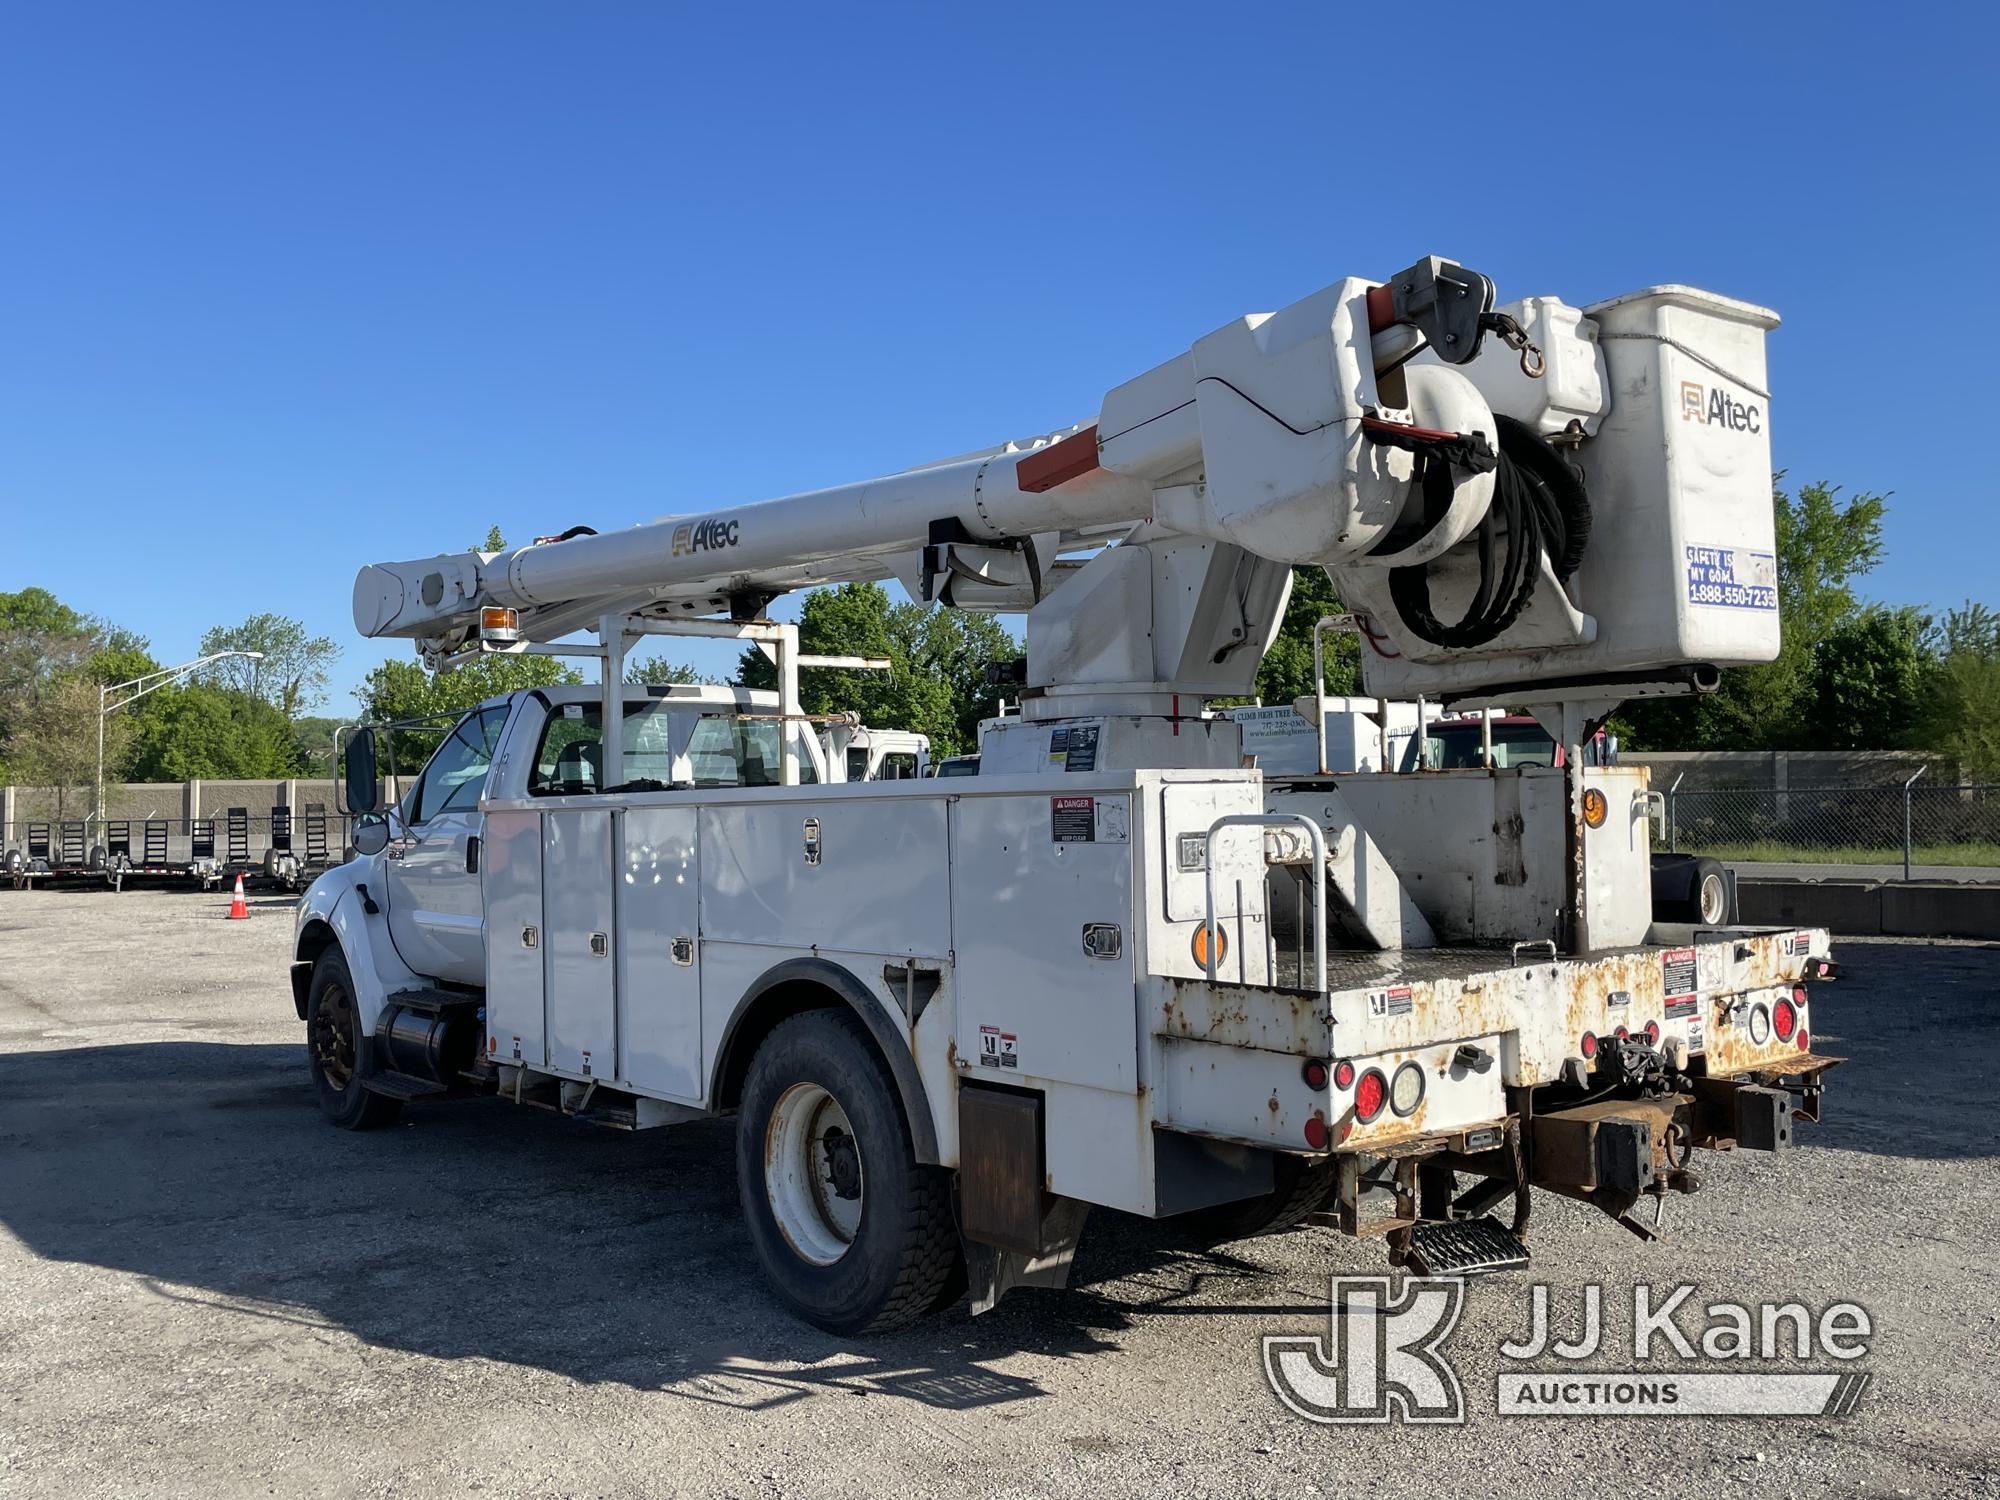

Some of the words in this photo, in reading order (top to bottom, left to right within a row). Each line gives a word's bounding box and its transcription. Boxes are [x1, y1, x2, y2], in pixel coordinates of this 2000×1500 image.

[1707, 388, 1760, 434] Altec
[692, 518, 739, 552] Altec
[1687, 548, 1721, 567] SAFETY
[1723, 552, 1734, 567] IS
[1690, 566, 1705, 582] MY
[1708, 568, 1733, 584] GOAL
[1237, 711, 1257, 720] CLIMB
[1258, 711, 1273, 720] HIGH
[1064, 799, 1089, 808] DANGER
